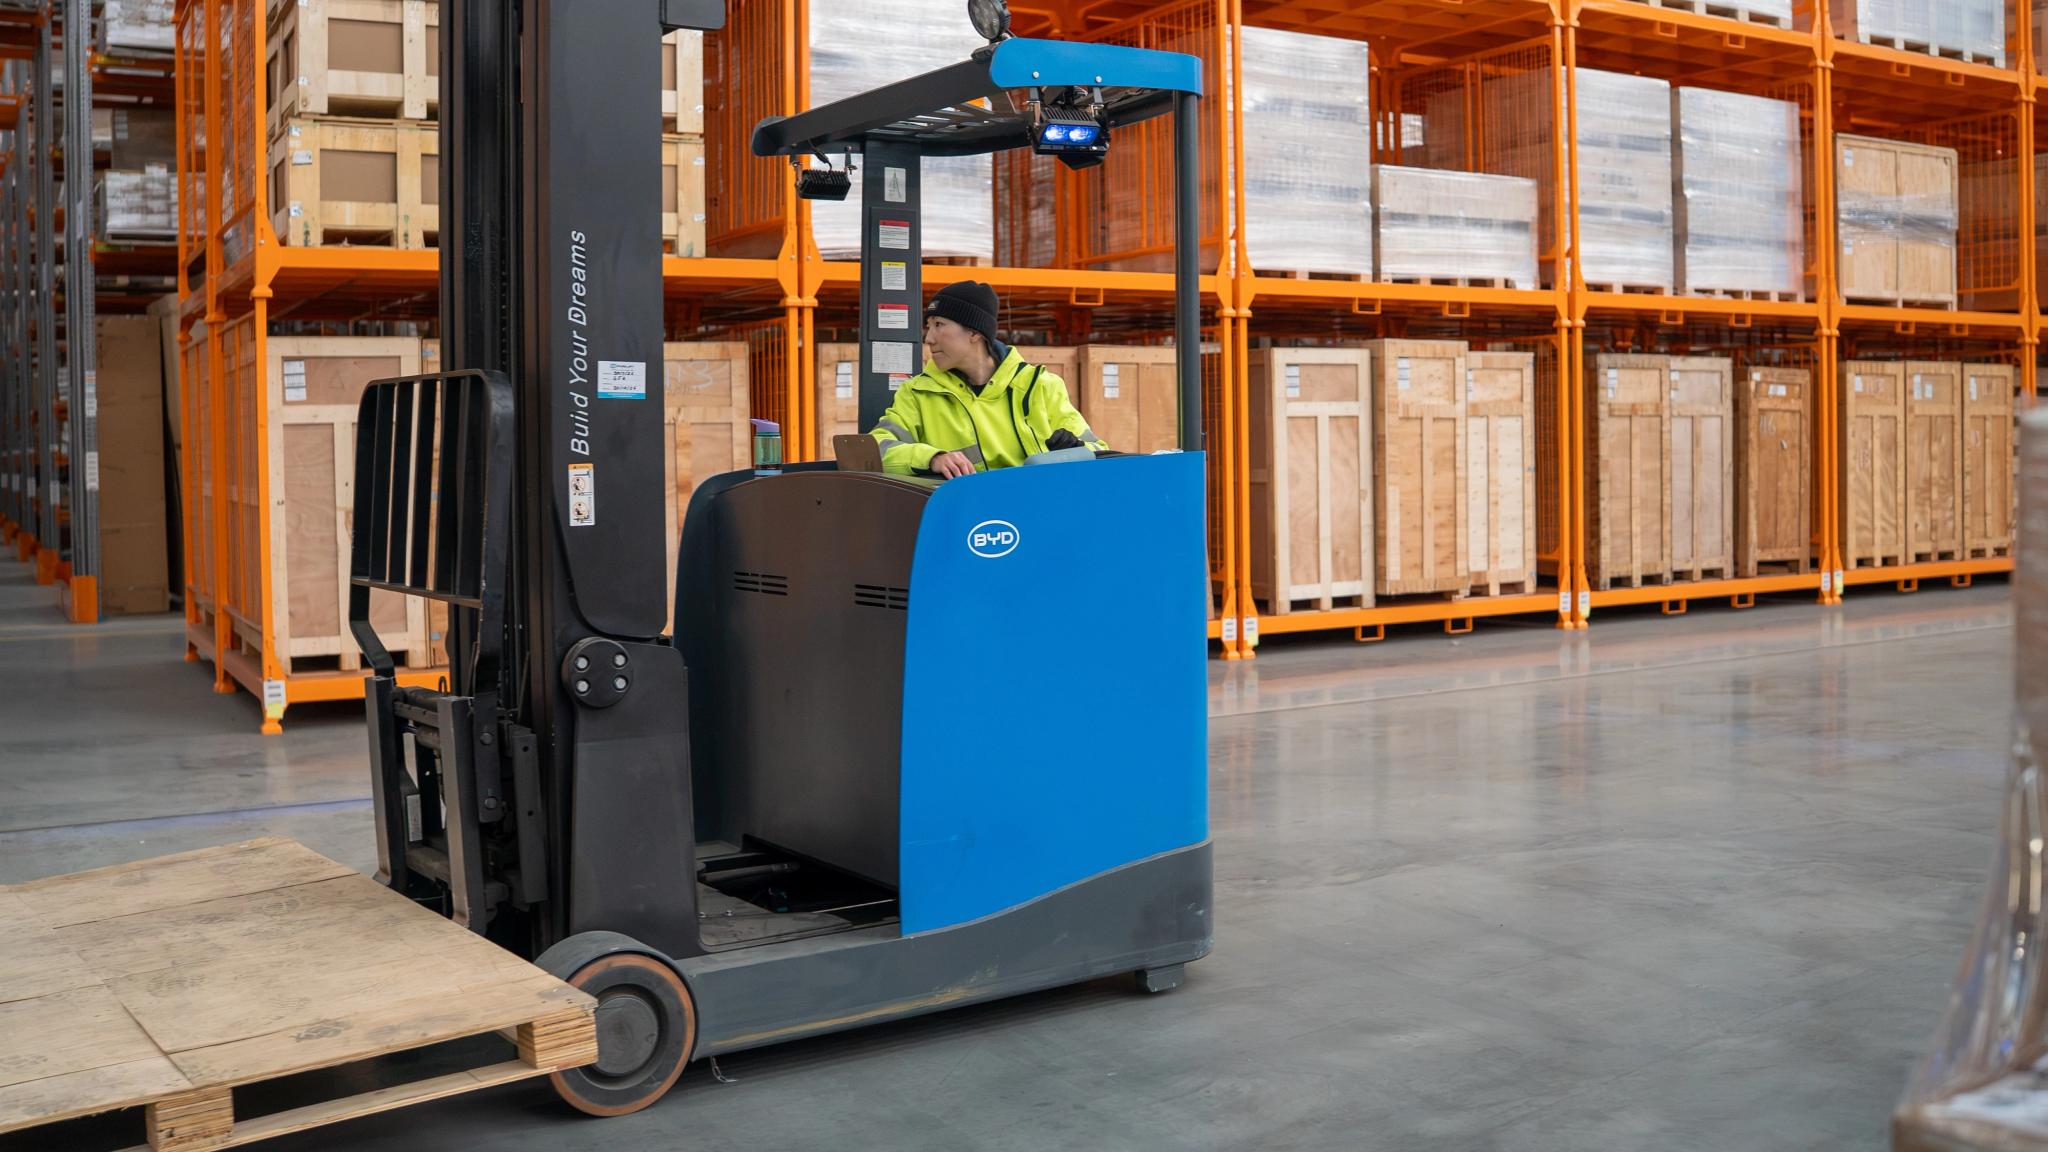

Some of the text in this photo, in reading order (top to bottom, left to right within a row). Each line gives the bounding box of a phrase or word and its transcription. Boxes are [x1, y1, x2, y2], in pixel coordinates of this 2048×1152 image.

[567, 230, 588, 327] Dreams
[569, 330, 589, 384] Your
[974, 531, 1014, 547] BYD
